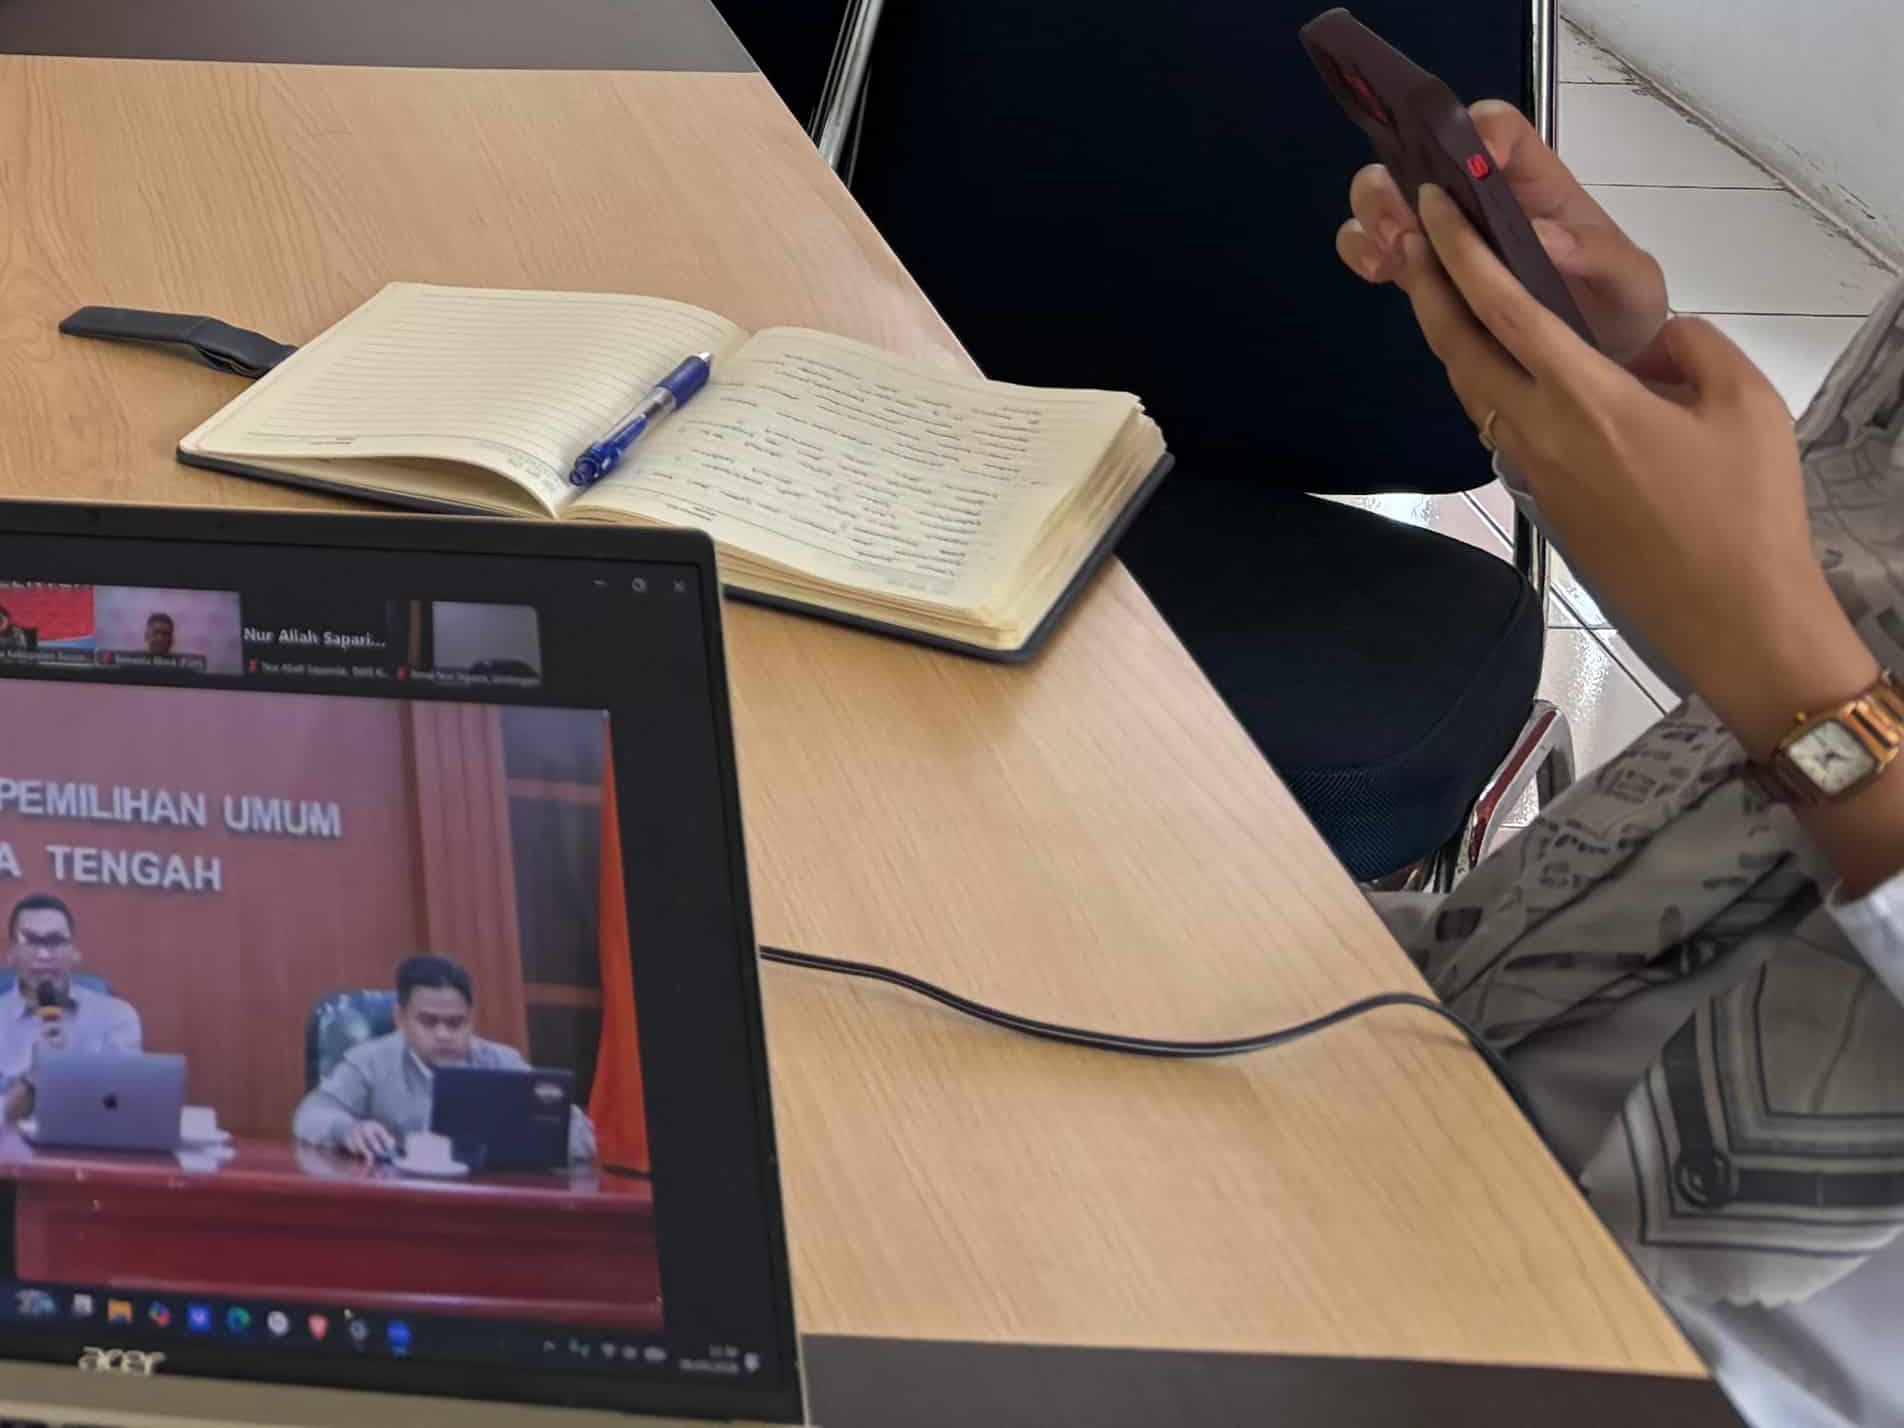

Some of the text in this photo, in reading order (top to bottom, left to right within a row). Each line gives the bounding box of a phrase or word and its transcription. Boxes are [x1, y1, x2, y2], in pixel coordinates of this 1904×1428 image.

[243, 627, 273, 642] Nur
[223, 795, 343, 838] UMUM
[46, 845, 223, 892] TENGAH
[78, 1346, 167, 1376] acer
